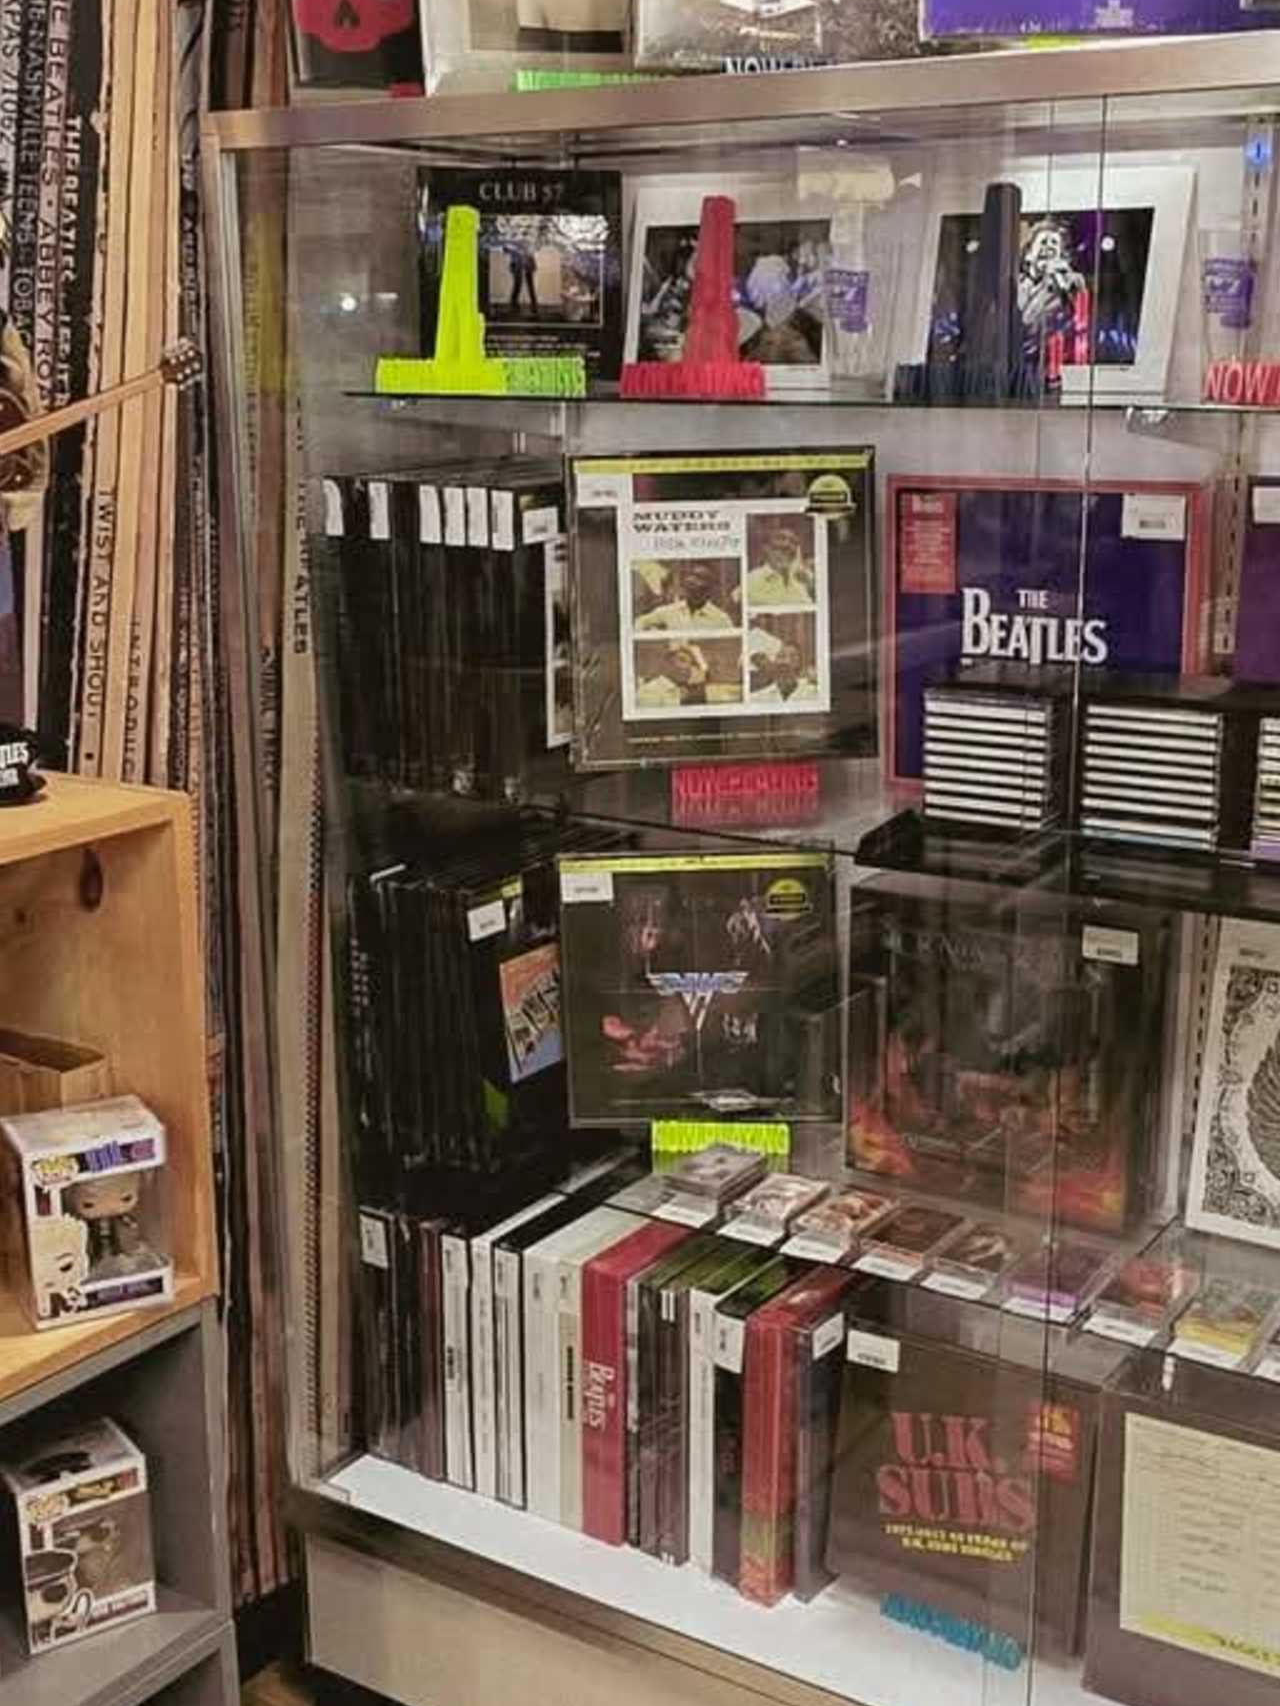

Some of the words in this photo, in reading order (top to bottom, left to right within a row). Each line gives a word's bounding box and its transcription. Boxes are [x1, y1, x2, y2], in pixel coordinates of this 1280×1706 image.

[14, 265, 35, 345] TOBAC
[35, 331, 54, 409] ROA
[1204, 361, 1270, 401] NOW
[962, 588, 1108, 665] BEATLES
[1019, 589, 1049, 609] THE
[122, 621, 141, 783] INTRODUC
[877, 1465, 1039, 1534] SUBS
